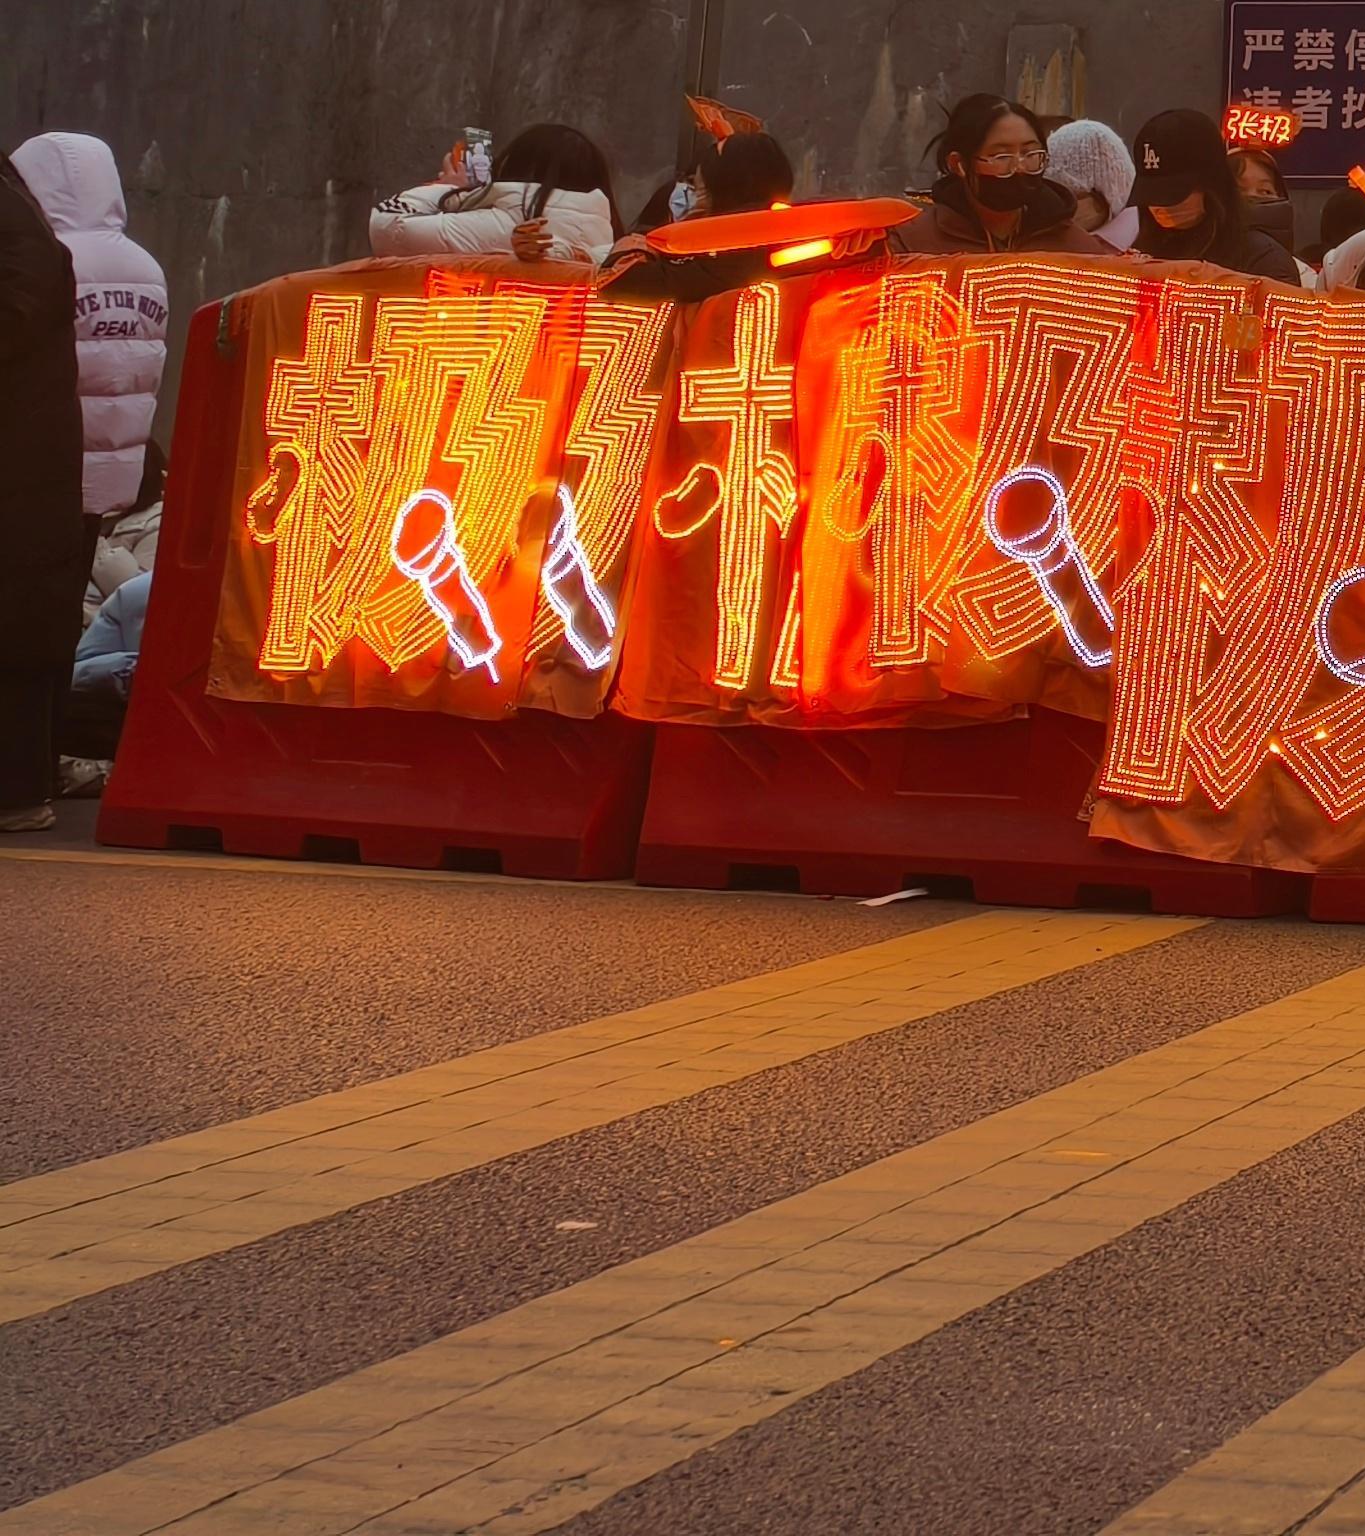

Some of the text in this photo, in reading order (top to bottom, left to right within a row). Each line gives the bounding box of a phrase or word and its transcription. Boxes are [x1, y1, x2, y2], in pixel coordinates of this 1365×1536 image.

[1227, 109, 1292, 144] 张极
[1143, 143, 1160, 169] LA
[103, 290, 135, 309] FOR
[91, 319, 139, 337] PEAK
[248, 293, 550, 674] 极
